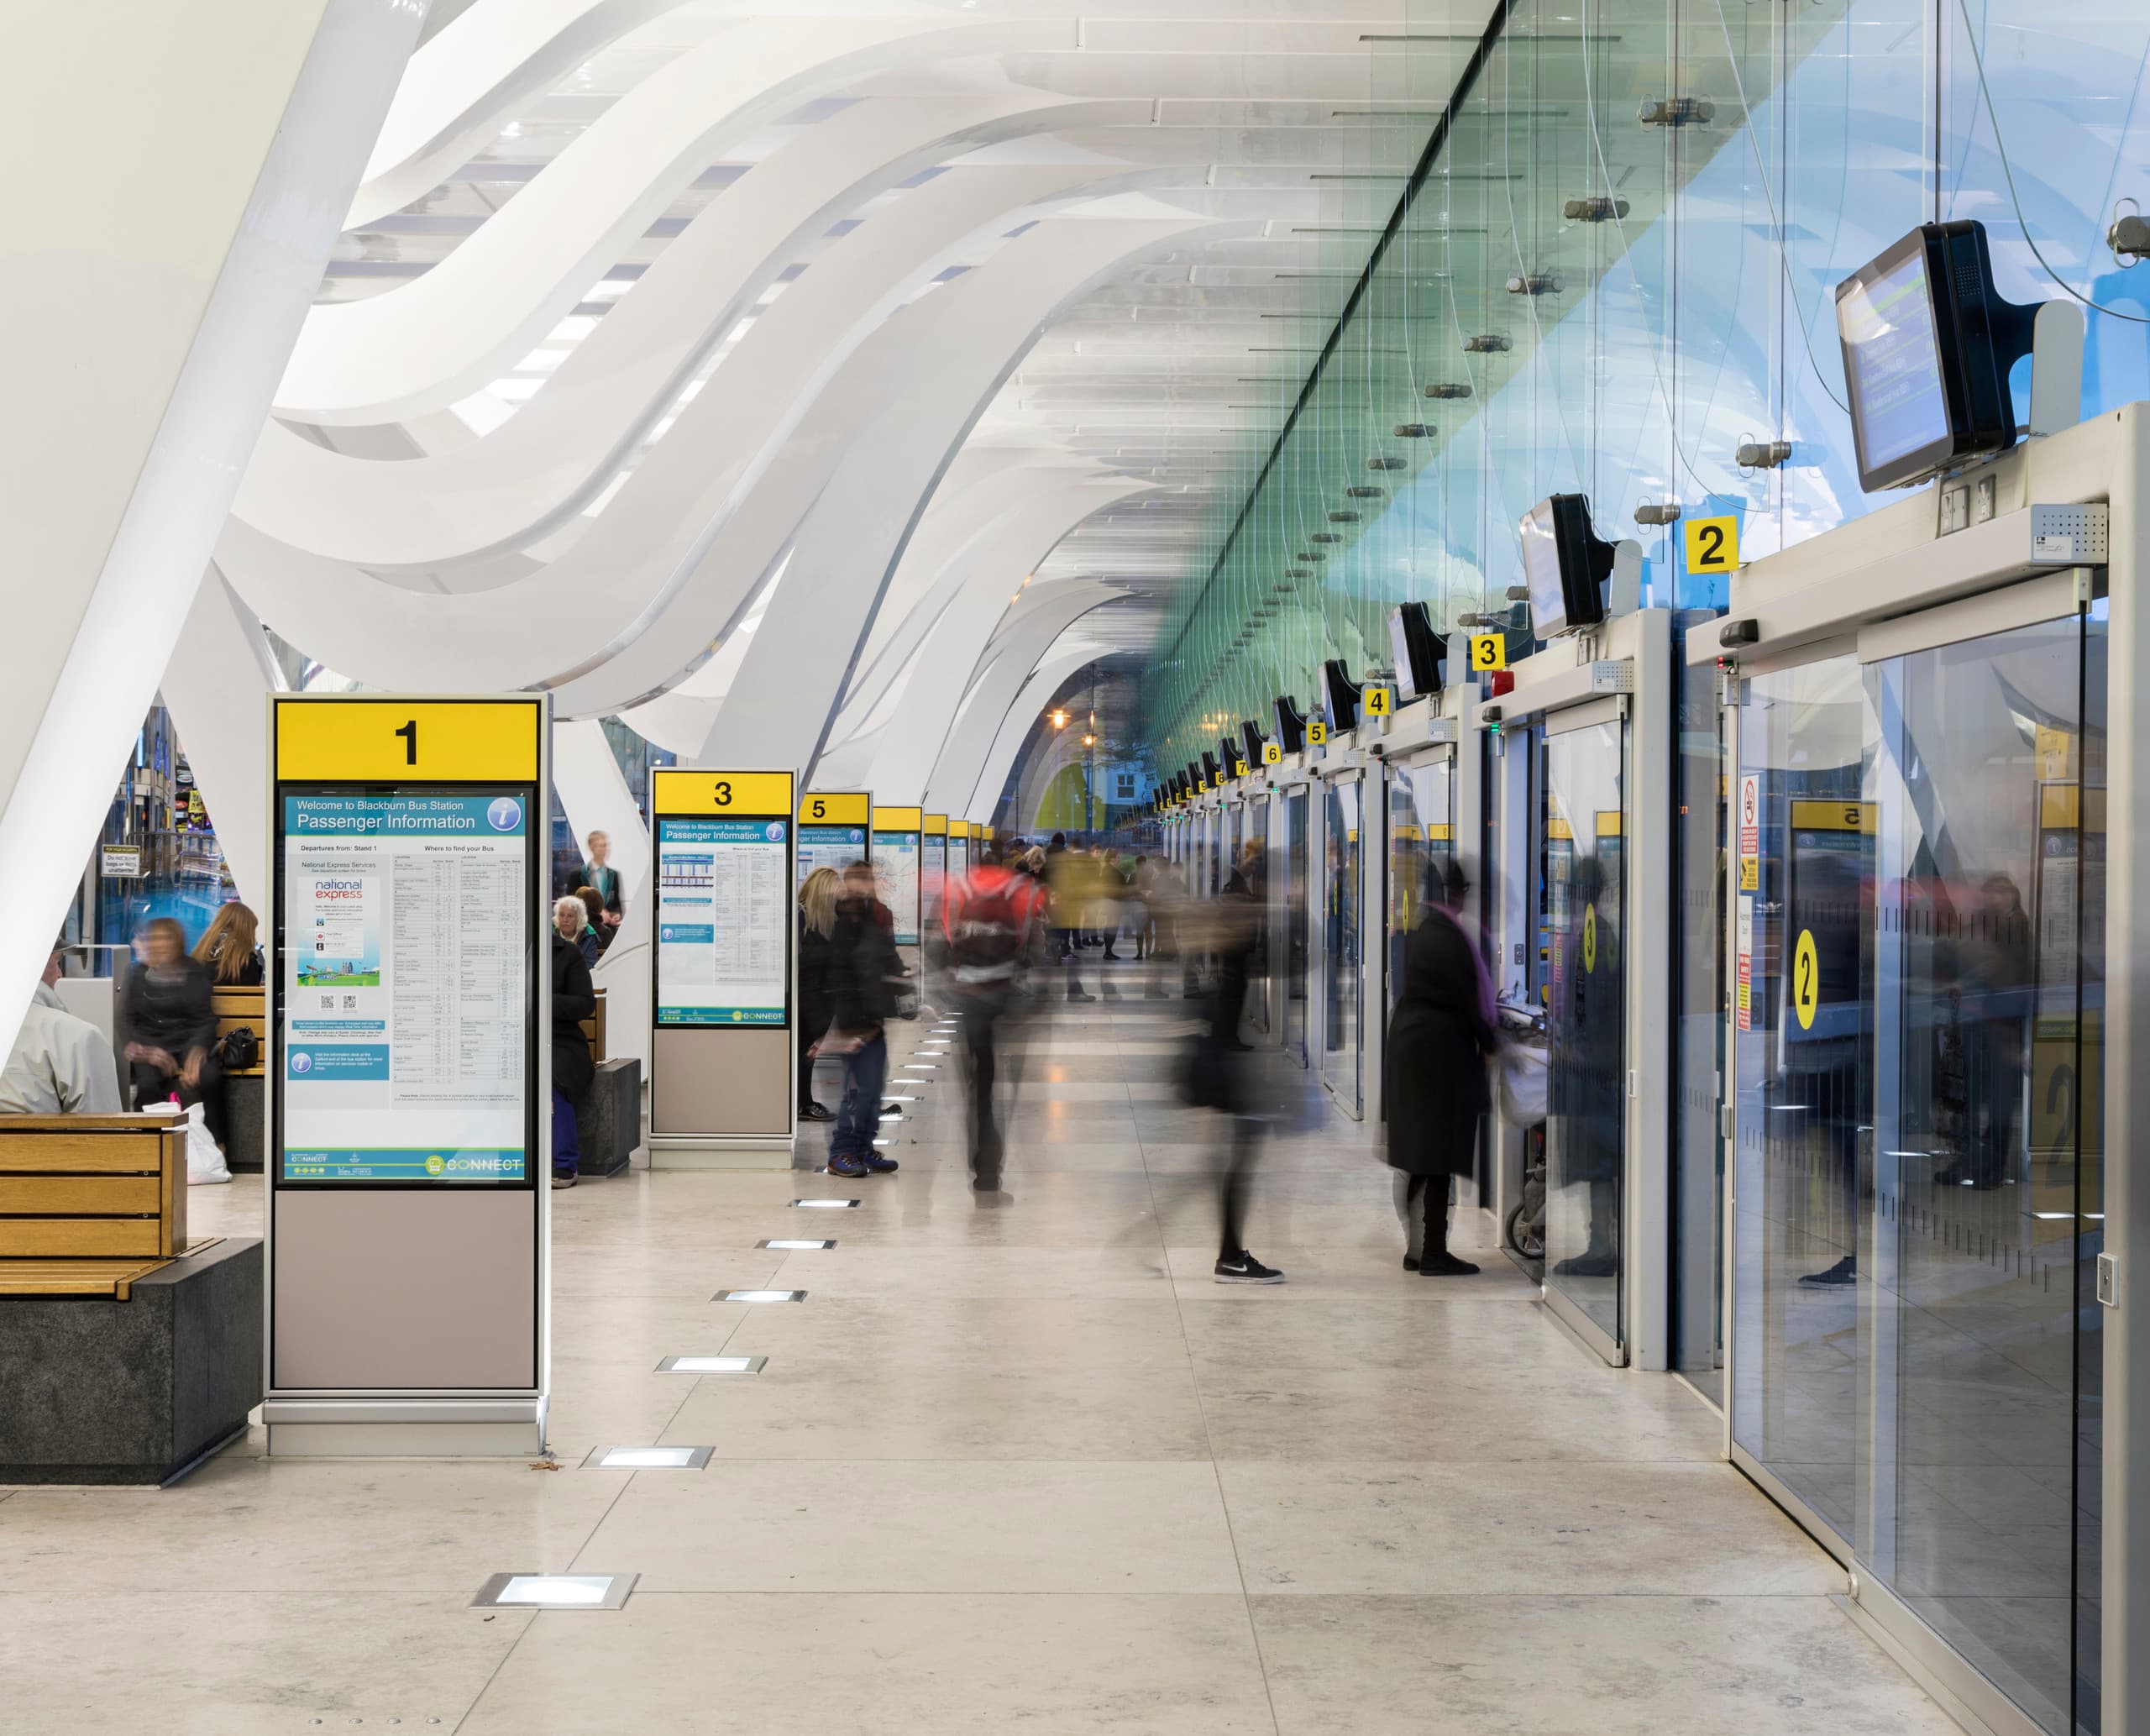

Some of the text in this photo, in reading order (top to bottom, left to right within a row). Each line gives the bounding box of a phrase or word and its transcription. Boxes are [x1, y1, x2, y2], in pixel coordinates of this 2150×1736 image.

[1698, 525, 1725, 565] 2
[1480, 639, 1497, 665] 3
[1371, 692, 1383, 711] 4
[1312, 726, 1321, 741] 5
[395, 720, 417, 765] 1
[1269, 747, 1277, 760] 6
[1240, 763, 1245, 774] 7
[1218, 774, 1224, 783] 8
[714, 781, 732, 806] 3
[297, 800, 464, 811] Welcome to Blackburn Bus Station
[812, 800, 826, 818] 5
[297, 814, 475, 831] Passenger Information
[666, 831, 760, 841] Passenger Information
[316, 878, 363, 890] national
[316, 890, 363, 901] express
[1587, 919, 1592, 957] 3
[1801, 951, 1811, 1005] 2
[447, 1159, 522, 1171] CONNECT
